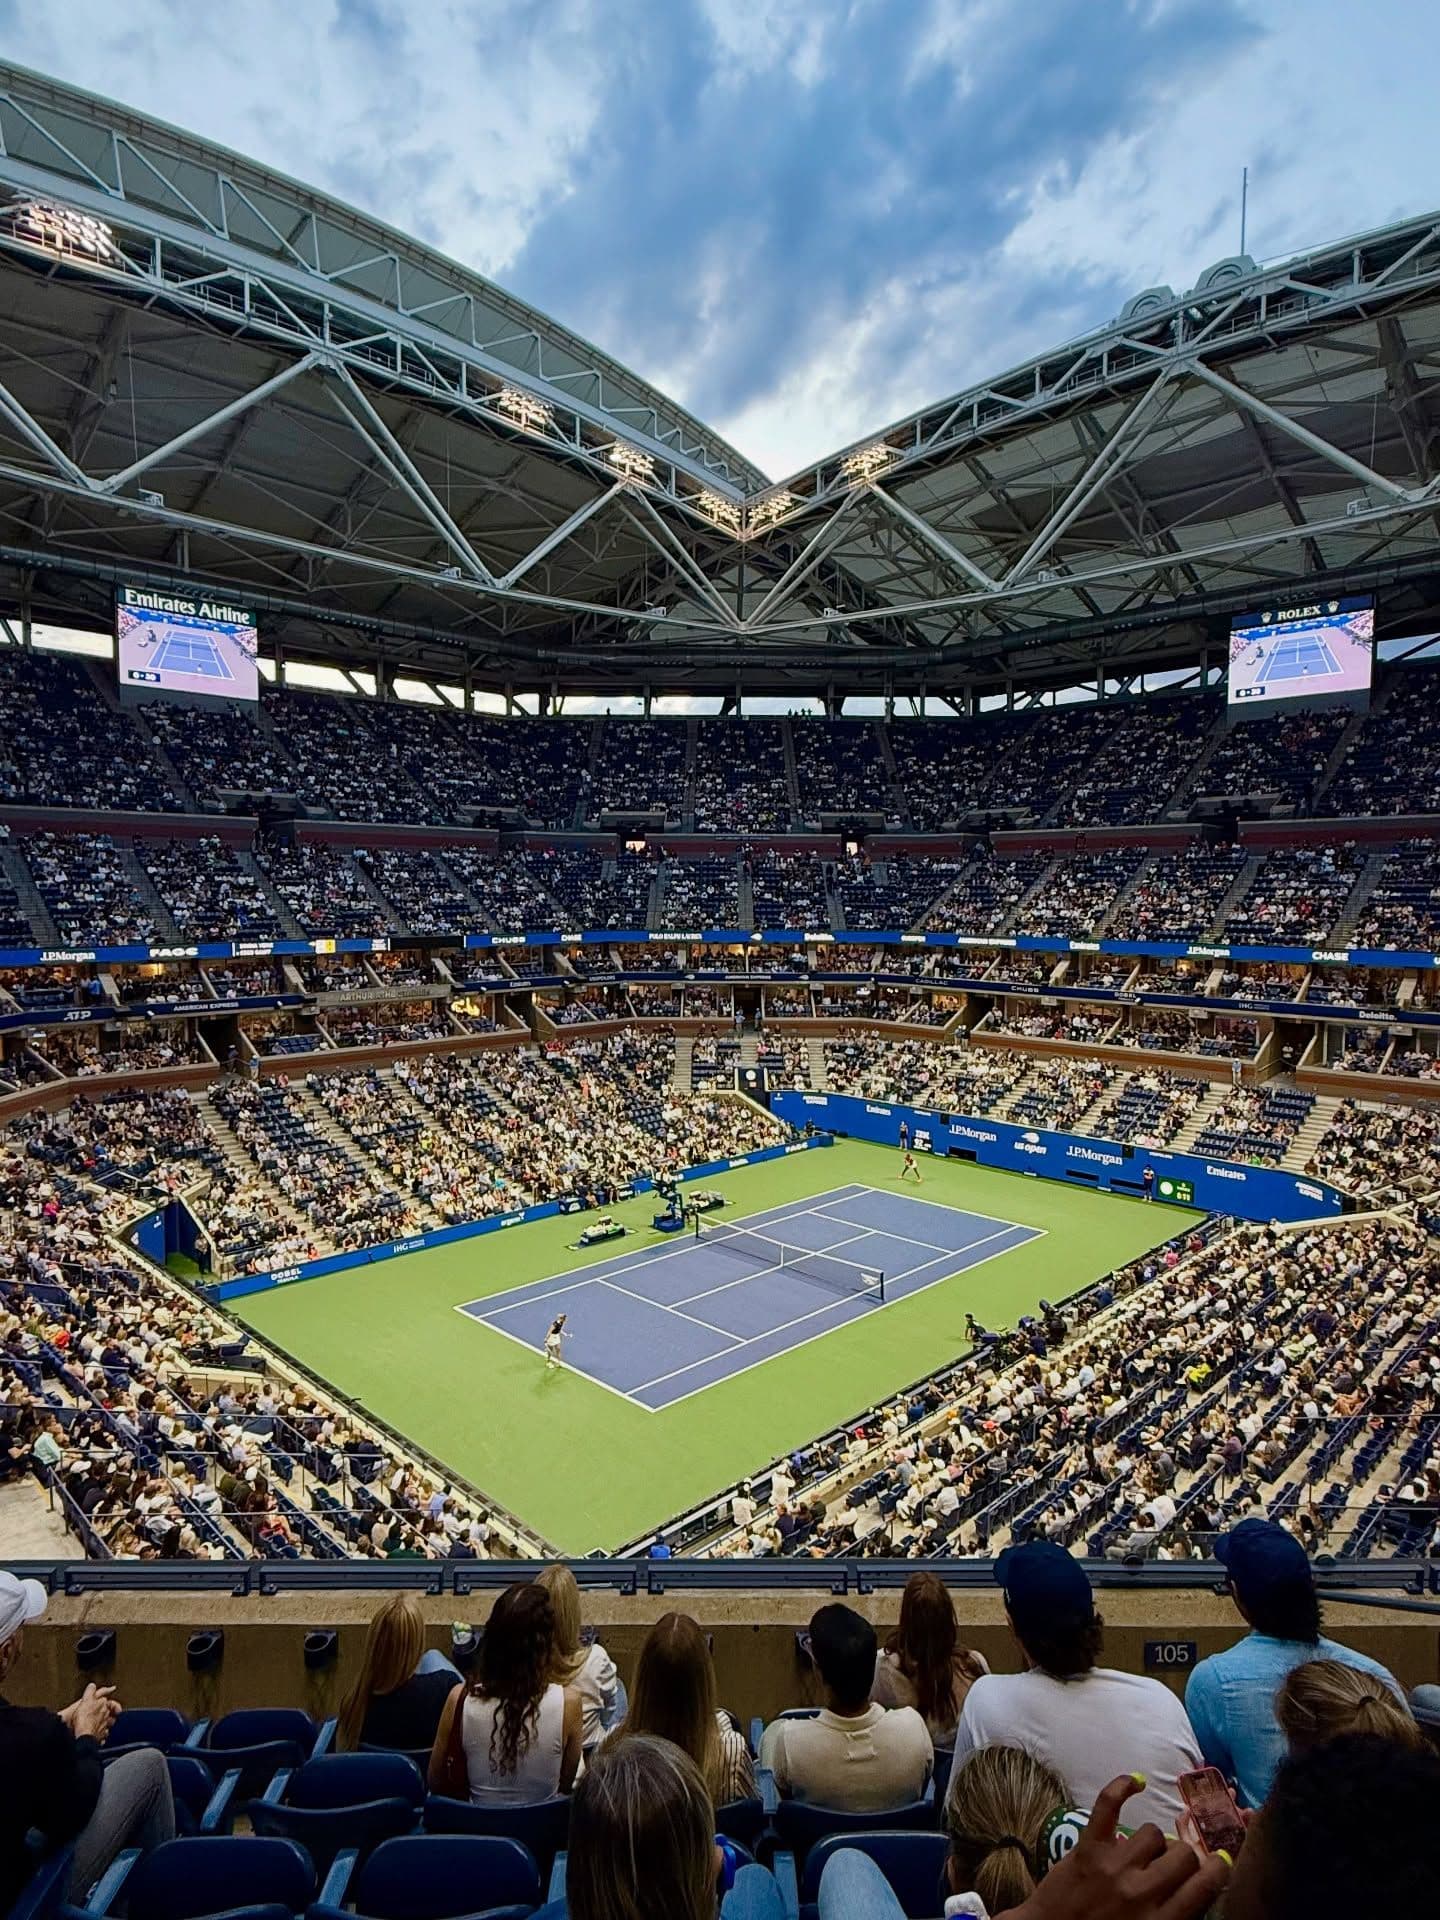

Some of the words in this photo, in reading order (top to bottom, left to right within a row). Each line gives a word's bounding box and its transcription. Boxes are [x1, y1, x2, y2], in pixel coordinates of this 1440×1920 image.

[125, 589, 195, 614] Emirates
[199, 603, 250, 624] Airline
[1278, 605, 1321, 620] ROLEX
[39, 951, 96, 962] J.P.Morgan
[1187, 947, 1230, 957] J.P.Morgan
[1312, 951, 1349, 961] CHASE
[915, 978, 949, 986] CADILLAC
[1010, 985, 1040, 993] CHUBB
[339, 993, 373, 1001] ARTHUR
[1114, 991, 1137, 999] DOBEL
[173, 1003, 209, 1012] AMERICAN
[209, 1001, 239, 1009] EXPRESS
[1238, 1002, 1253, 1010] IHG
[64, 1010, 92, 1021] ATP
[1359, 1010, 1397, 1020] Deloitte.
[948, 1124, 997, 1142] J.P.Morgan
[1024, 1144, 1047, 1155] open
[1066, 1145, 1123, 1166] J.P.Morgan
[1206, 1165, 1247, 1181] Emirates
[393, 1242, 409, 1253] IHG
[270, 1267, 302, 1281] DOBEL
[1155, 1644, 1189, 1663] 105
